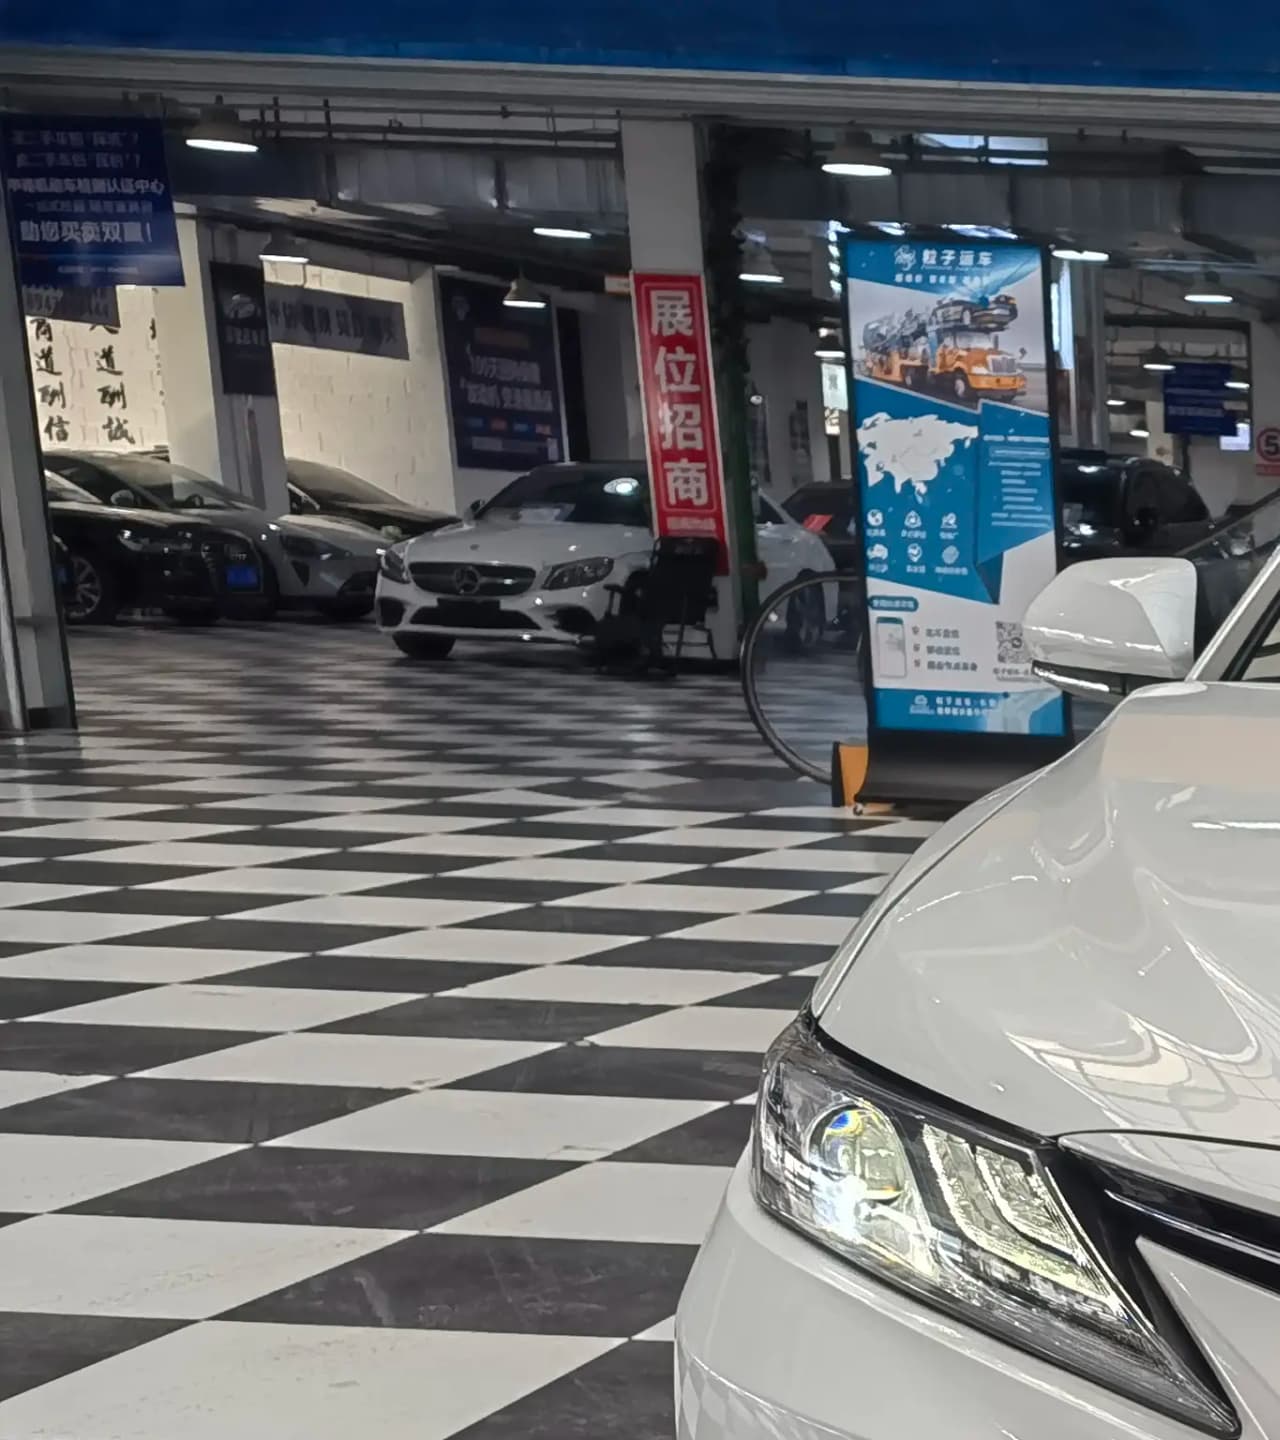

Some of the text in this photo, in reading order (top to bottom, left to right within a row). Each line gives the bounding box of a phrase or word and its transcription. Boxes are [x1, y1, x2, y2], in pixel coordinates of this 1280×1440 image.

[650, 289, 709, 506] 展位招商
[1265, 435, 1280, 456] 5
